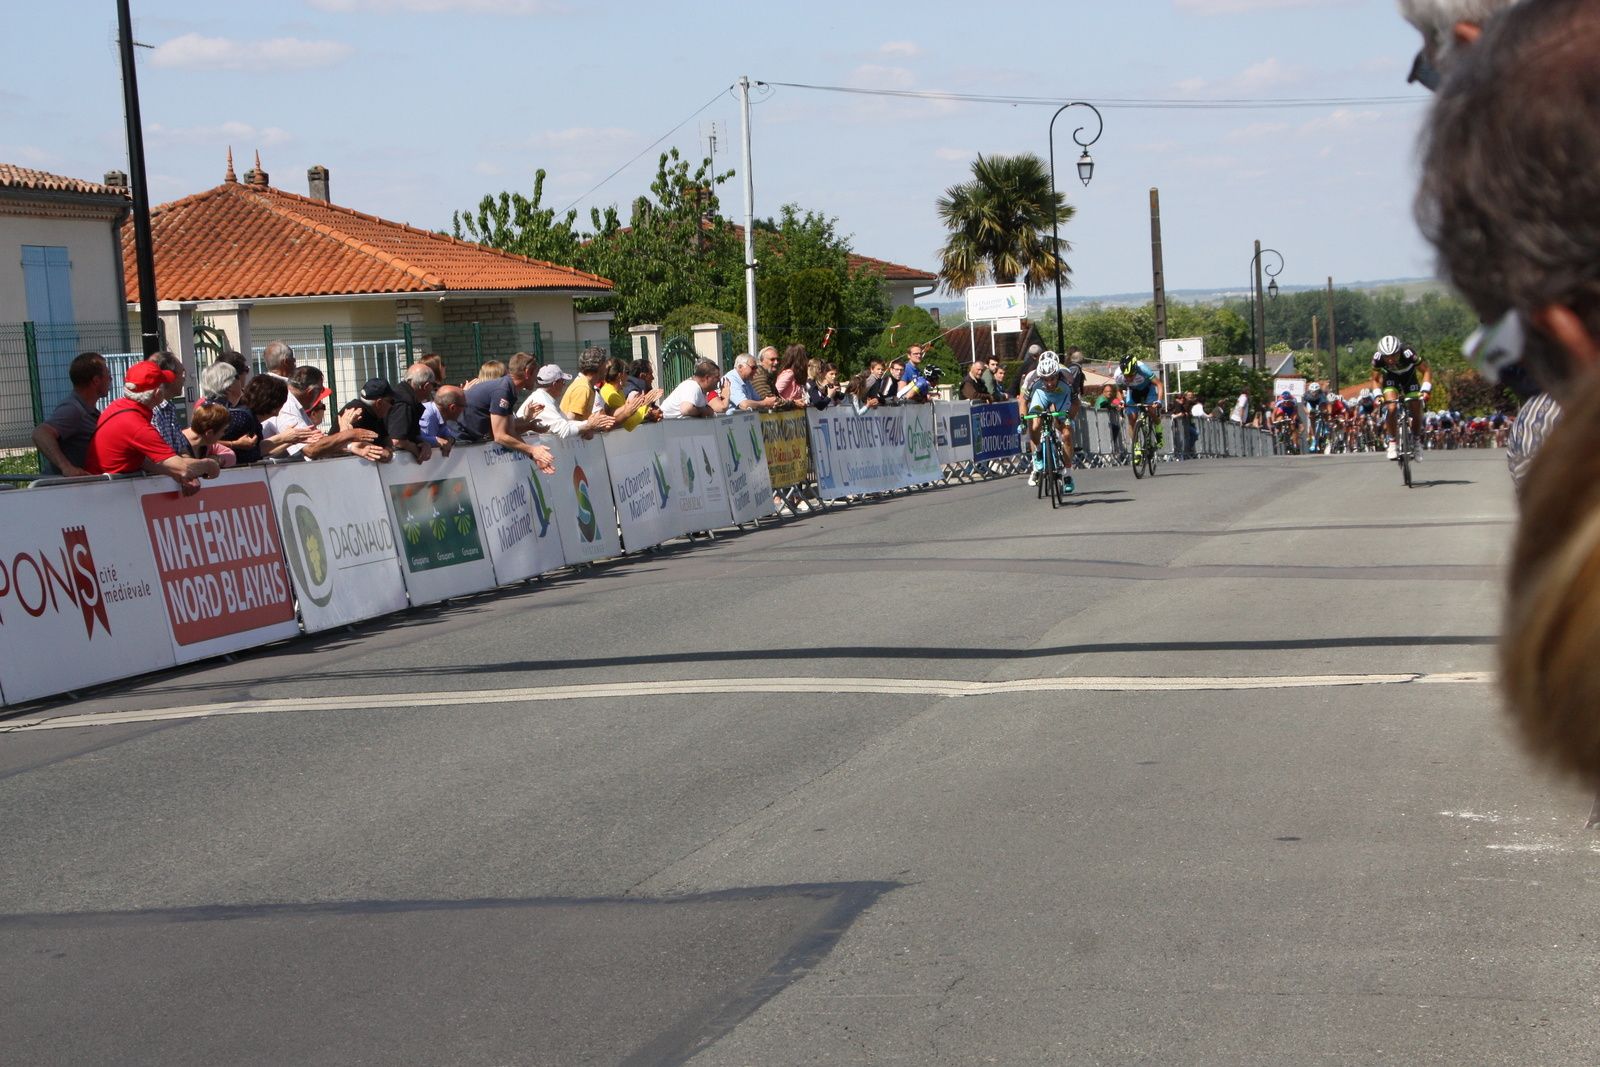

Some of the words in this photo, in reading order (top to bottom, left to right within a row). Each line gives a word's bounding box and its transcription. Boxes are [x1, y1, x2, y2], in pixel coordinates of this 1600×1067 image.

[624, 465, 652, 498] Charente
[481, 504, 493, 529] la
[490, 483, 527, 522] Charente
[629, 489, 655, 521] Maritime
[152, 501, 277, 572] MATÉRIAUX
[329, 518, 393, 560] DAGNAUD
[497, 511, 533, 552] Maritime
[100, 564, 118, 584] cité
[104, 579, 152, 605] médiévale
[166, 573, 223, 625] NORD
[220, 561, 287, 614] BLAYAIS
